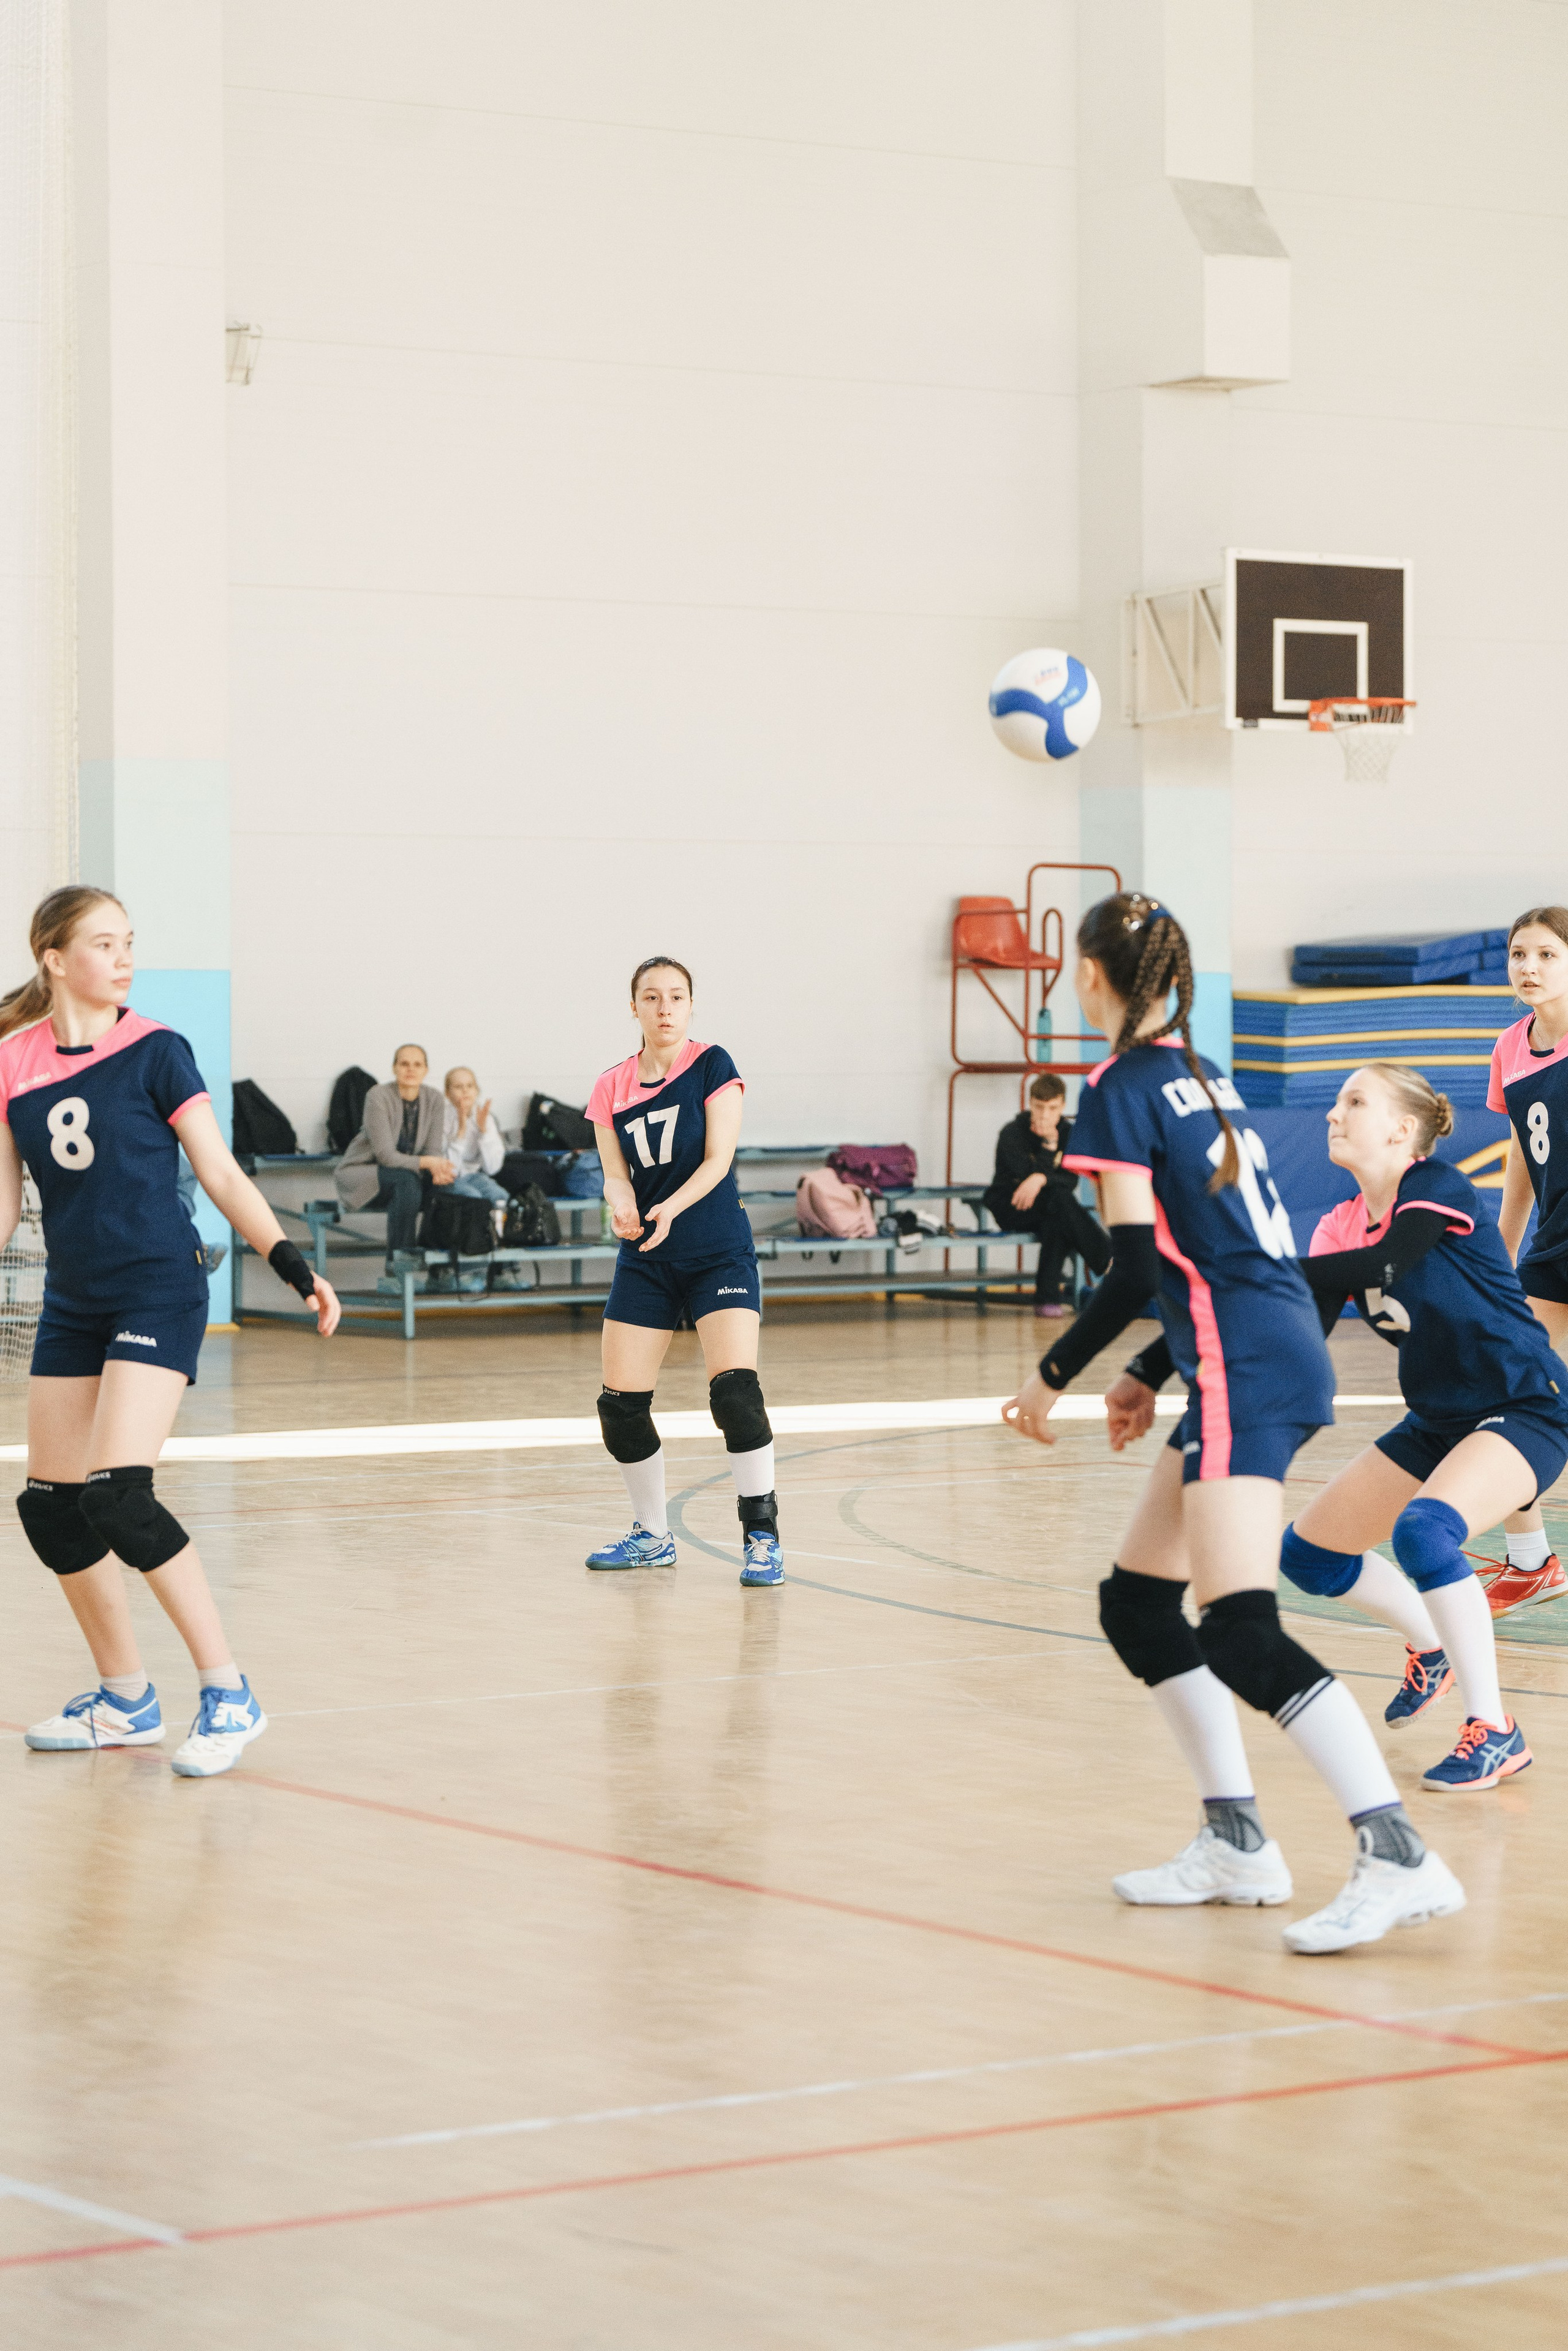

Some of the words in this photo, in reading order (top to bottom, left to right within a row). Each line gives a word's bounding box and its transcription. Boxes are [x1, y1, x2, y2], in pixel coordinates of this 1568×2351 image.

[47, 1096, 96, 1171] 8
[614, 1095, 639, 1109] MIKSA
[1527, 1101, 1550, 1164] 8
[624, 1104, 680, 1168] 17
